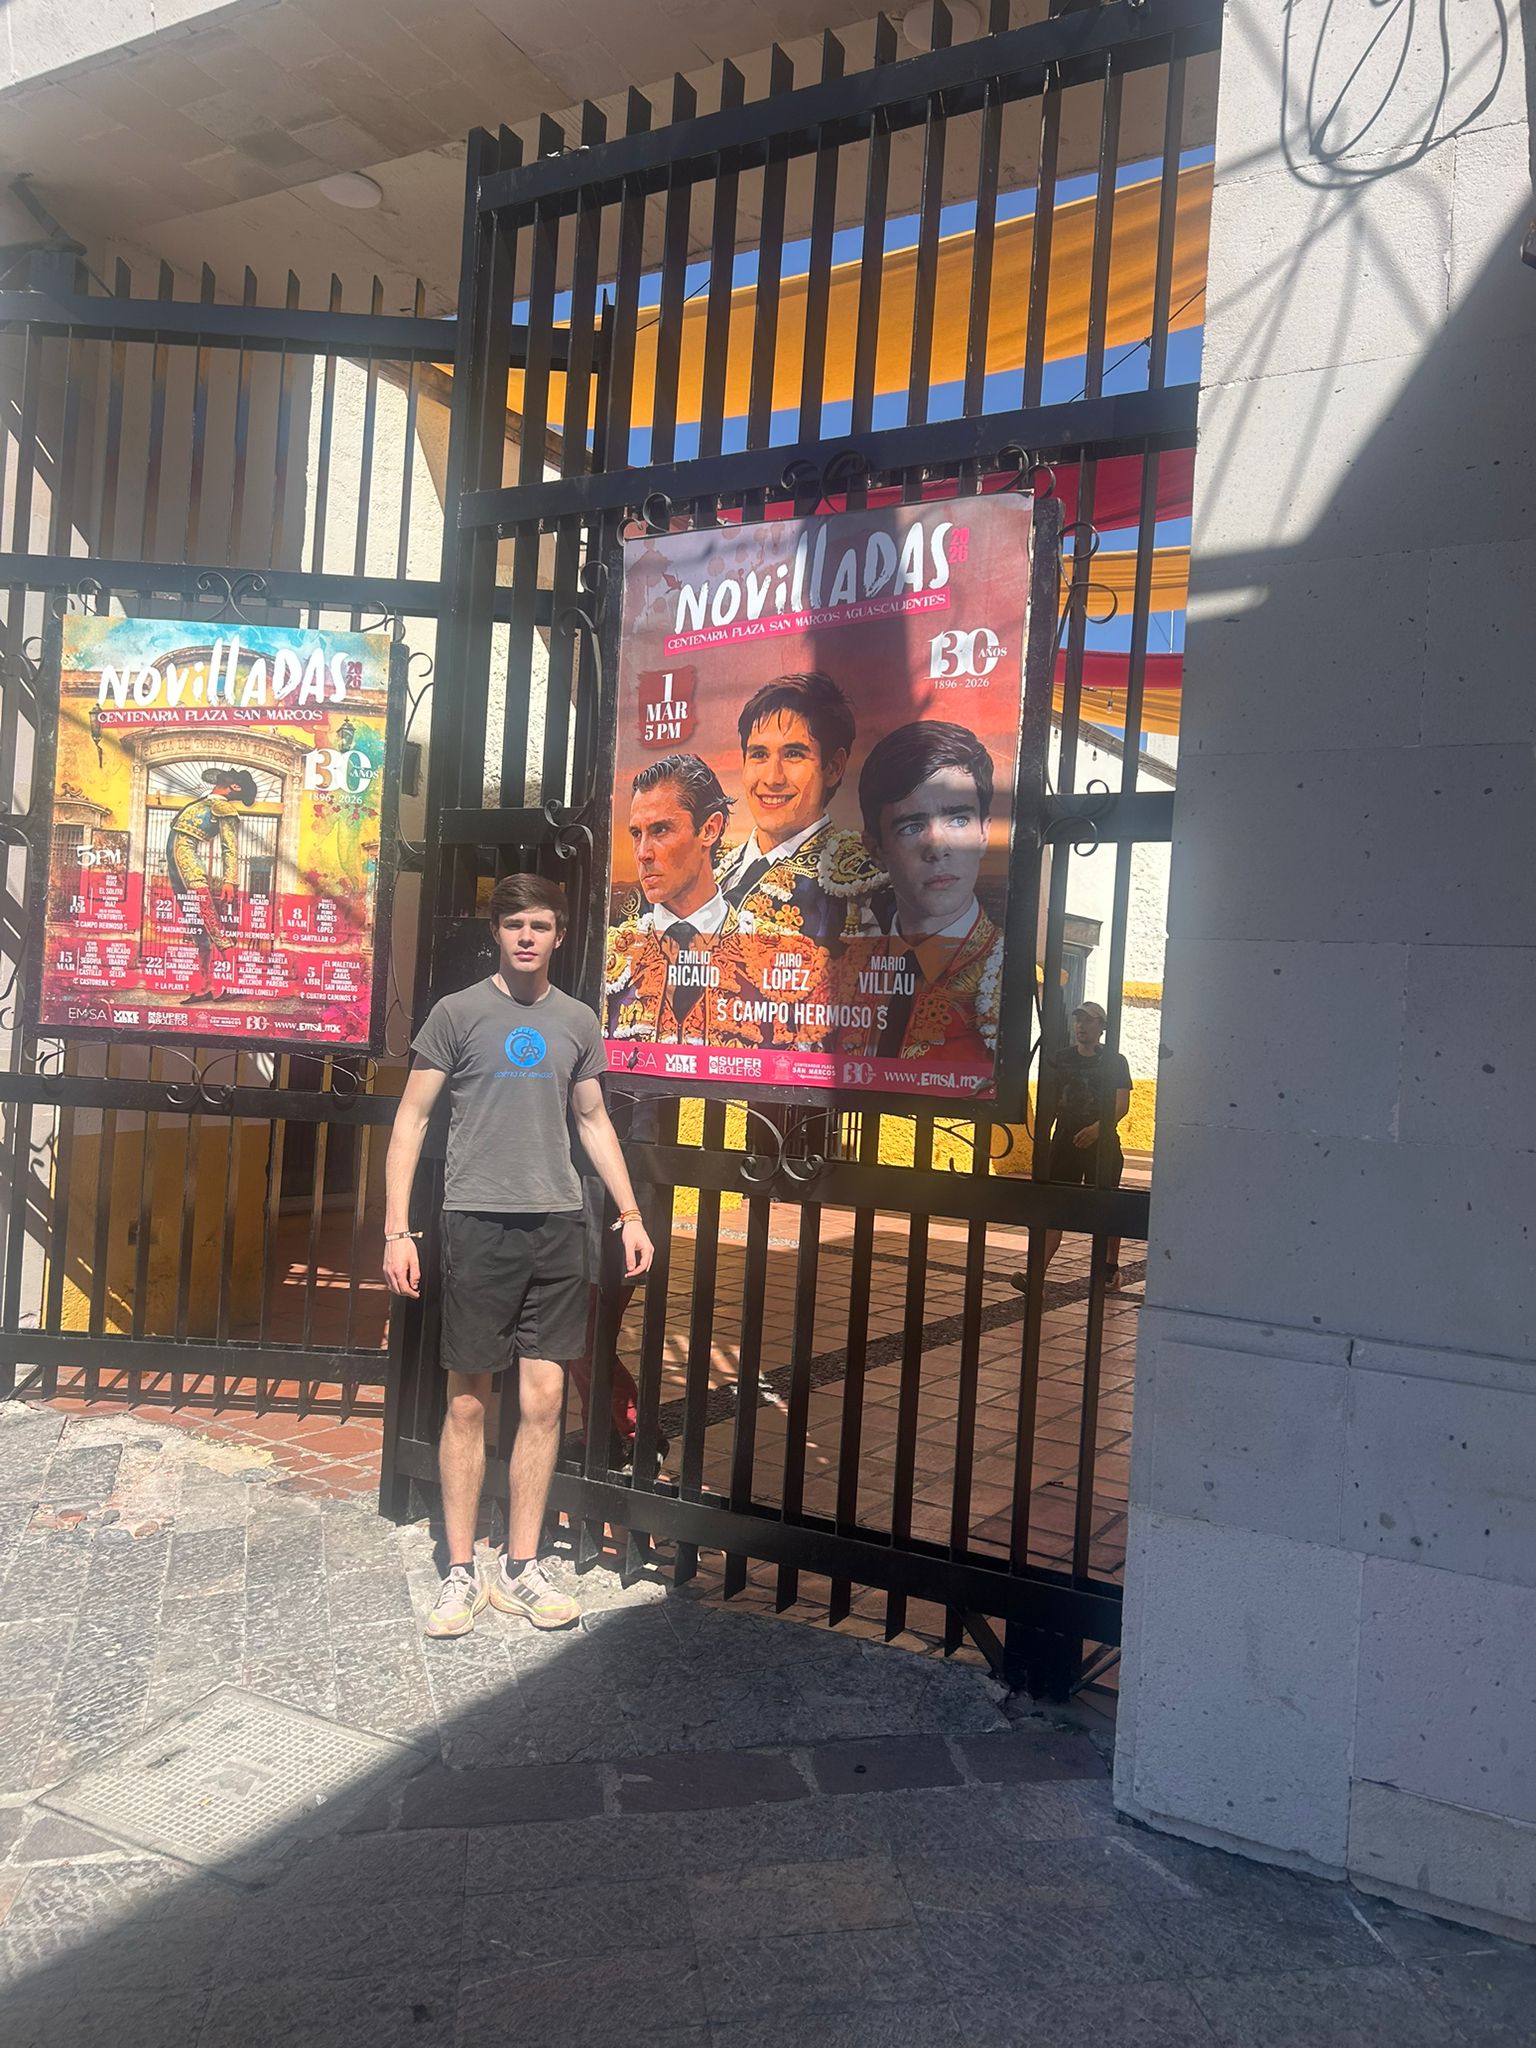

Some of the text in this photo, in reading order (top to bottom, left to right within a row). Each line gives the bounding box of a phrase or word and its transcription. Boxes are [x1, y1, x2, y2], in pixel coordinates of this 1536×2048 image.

[668, 593, 946, 650] CENTENARIA PLAZA SAN MARCOS AGUASCALIENTES
[924, 628, 1007, 679] 130 AÑOS
[661, 673, 673, 703] 1
[935, 680, 957, 690] 1896
[965, 678, 989, 689] 2026
[98, 708, 323, 723] CENTENARIA PLAZA SAN MARCOS
[646, 701, 688, 722] MAR
[644, 722, 681, 740] 5 PM
[302, 748, 372, 793] 130
[309, 793, 362, 804] 1896 2026
[72, 895, 85, 906] 15
[156, 899, 172, 911] 22
[70, 905, 86, 913] FEB
[293, 908, 302, 919] 8
[220, 915, 239, 923] MAR
[287, 920, 306, 928] MAR
[245, 932, 270, 940] HERMOSO
[60, 951, 72, 963] 15
[145, 957, 162, 968] 22
[678, 950, 711, 965] EMILIO
[774, 953, 802, 968] JAIRO
[214, 961, 231, 972] 29
[871, 956, 906, 972] MARIO
[145, 968, 164, 976] MAR
[213, 972, 232, 980] MAR
[307, 967, 316, 977] 5
[668, 964, 720, 987] RICAUD
[303, 978, 320, 986] ABR
[763, 968, 811, 991] LOPEZ
[858, 972, 915, 996] VILLAU
[733, 1001, 789, 1024] CAMPO
[794, 1003, 871, 1028] HERMOSO
[665, 1054, 697, 1064] VIVE
[718, 1056, 761, 1067] SUPER
[665, 1063, 697, 1073] LIBRE
[718, 1066, 761, 1077] BOLETOS
[809, 1068, 836, 1076] MARCOS
